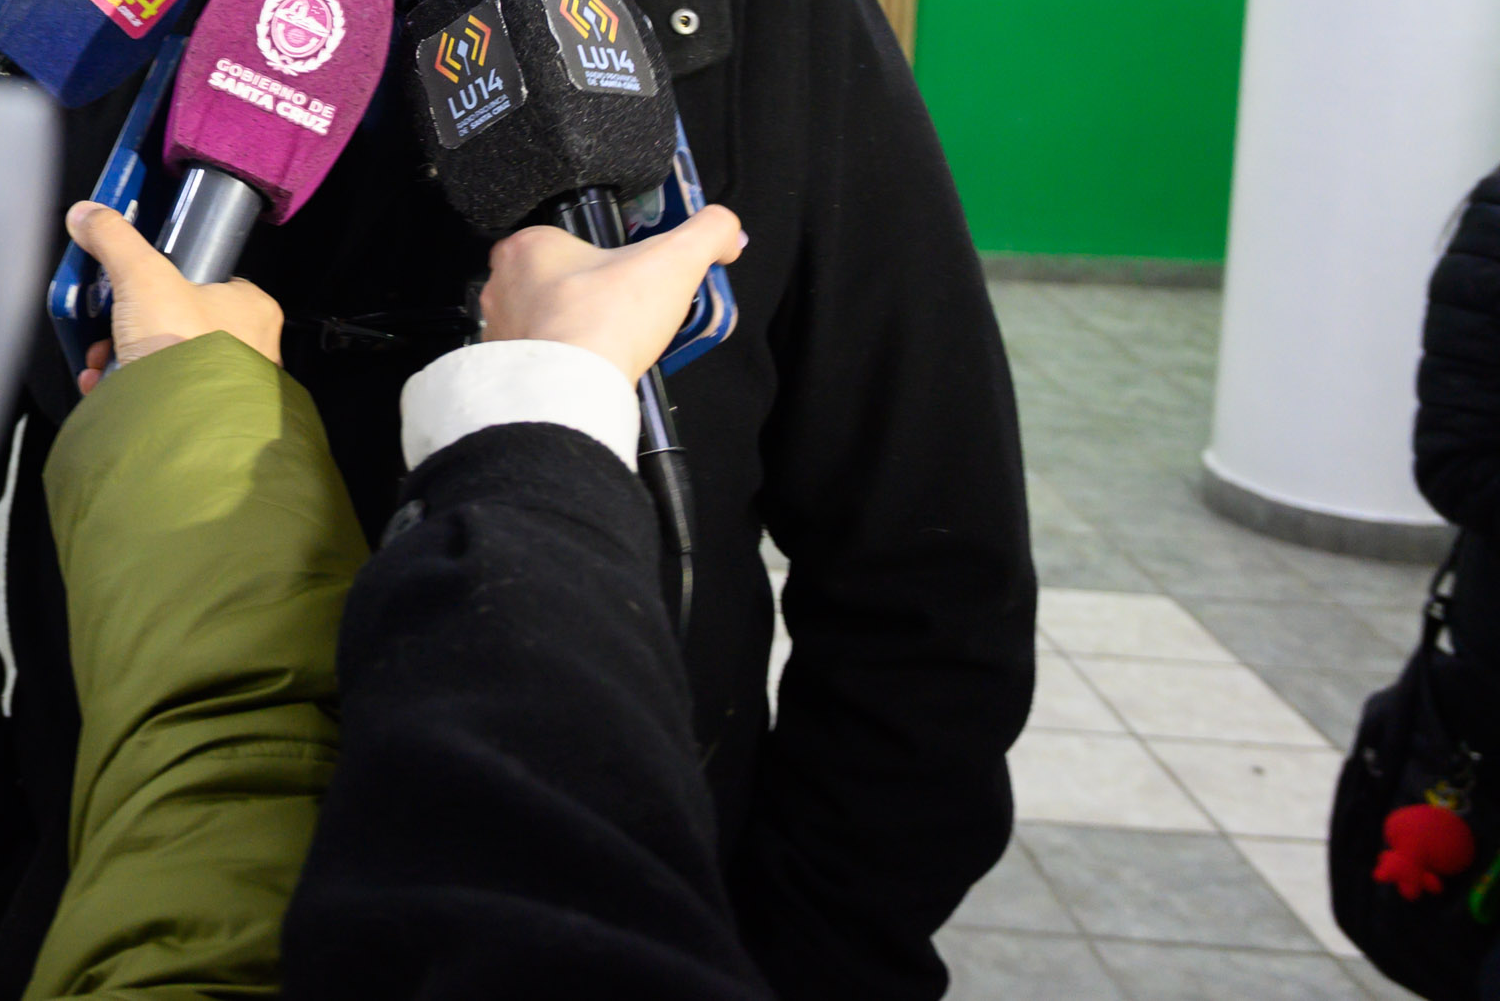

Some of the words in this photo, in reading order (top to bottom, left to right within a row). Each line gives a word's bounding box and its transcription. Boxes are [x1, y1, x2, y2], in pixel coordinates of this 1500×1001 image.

[577, 44, 635, 74] LU14
[207, 71, 274, 111] SANTA
[275, 101, 332, 136] CRUZ
[216, 58, 308, 106] GOBIERNO
[308, 98, 337, 119] DE
[448, 68, 504, 120] LU14
